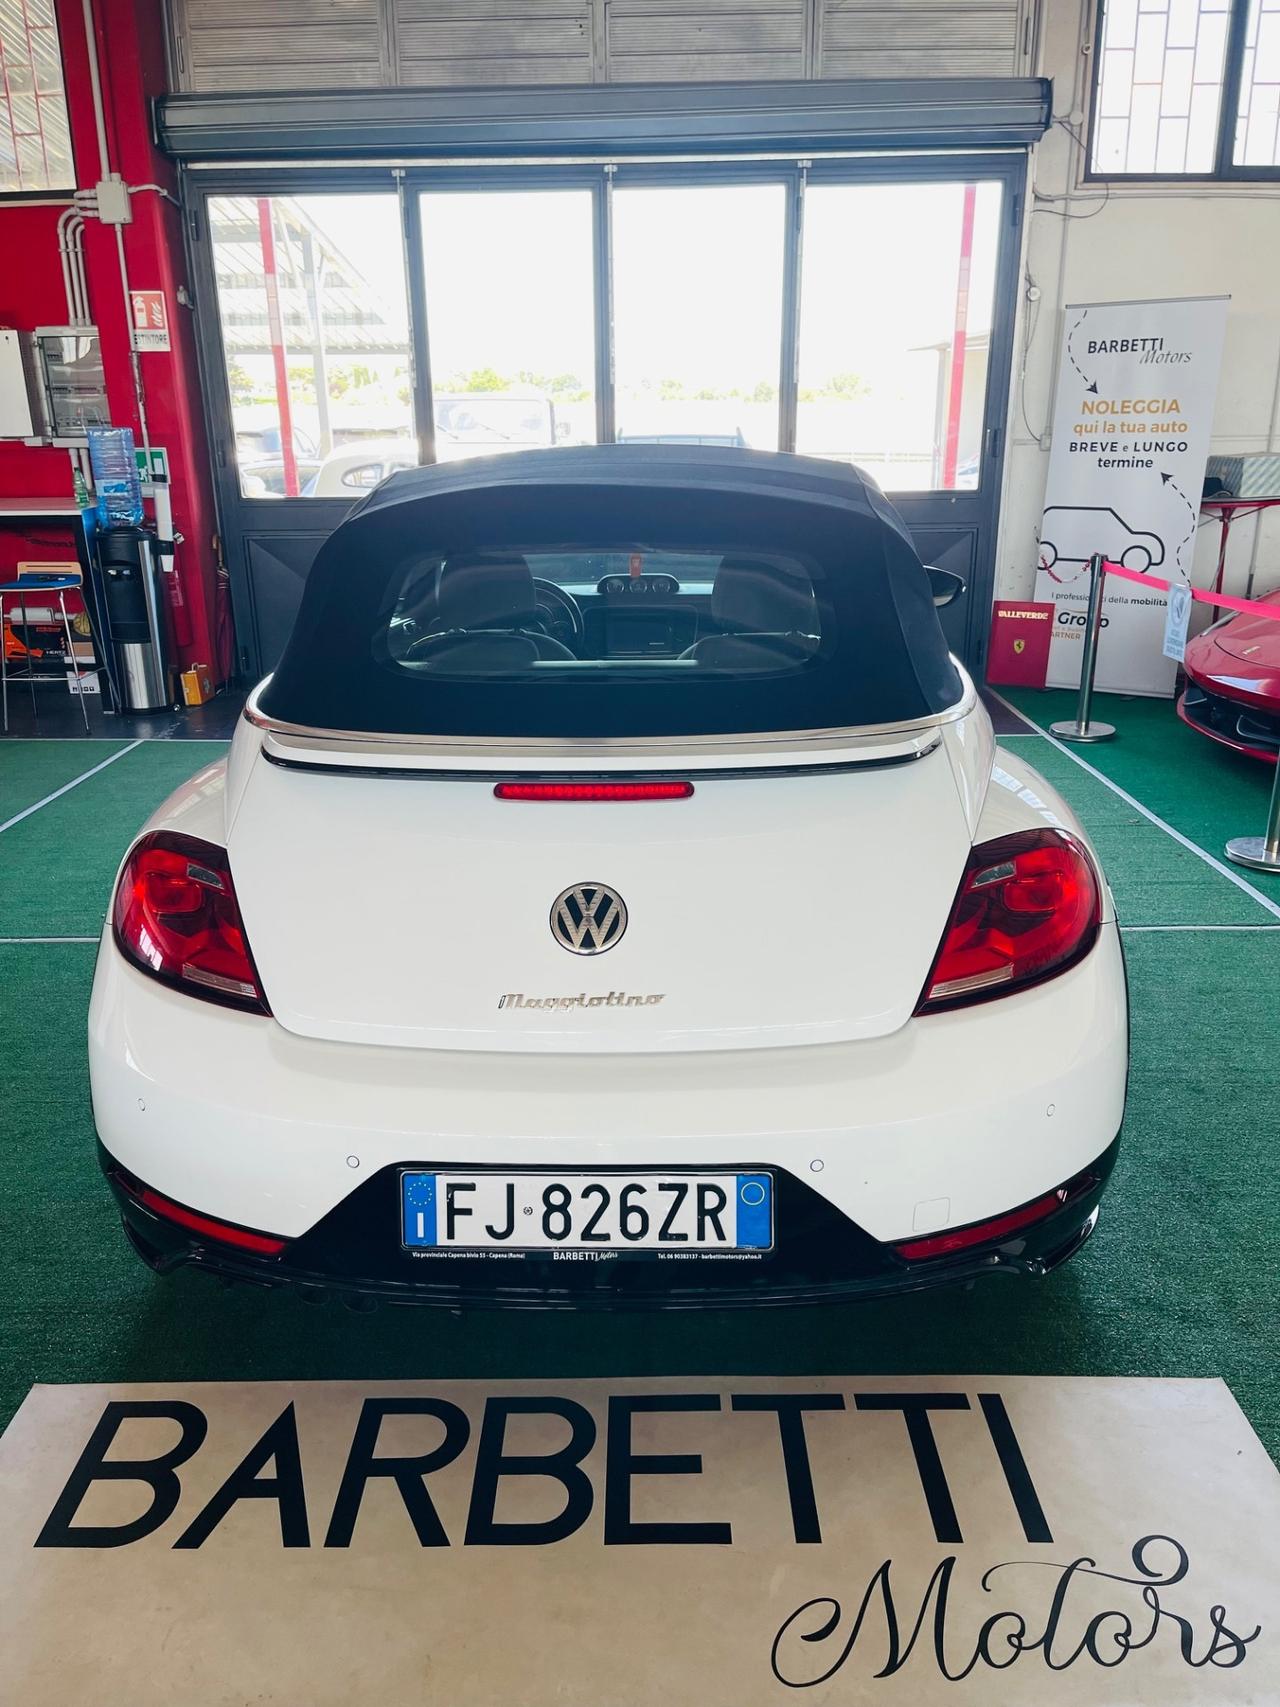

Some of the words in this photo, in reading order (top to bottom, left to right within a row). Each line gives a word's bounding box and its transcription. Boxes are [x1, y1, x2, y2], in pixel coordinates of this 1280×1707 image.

[133, 333, 168, 345] ESTINTORE
[1087, 338, 1164, 354] BARBETTI
[1139, 350, 1193, 364] Motors
[1081, 399, 1181, 415] NOLEGGIA
[1073, 420, 1099, 436] qui
[1102, 420, 1116, 433] la
[1120, 421, 1147, 433] tua
[1150, 420, 1188, 433] auto
[1069, 442, 1119, 452] BREVE
[1133, 441, 1188, 452] LUNGO
[1098, 456, 1154, 468] termine
[1108, 596, 1129, 604] della
[1057, 611, 1109, 628] Grop
[553, 1251, 599, 1260] BARBETTI
[34, 1393, 1054, 1549] BARBETTI
[770, 1535, 1262, 1688] Motors
